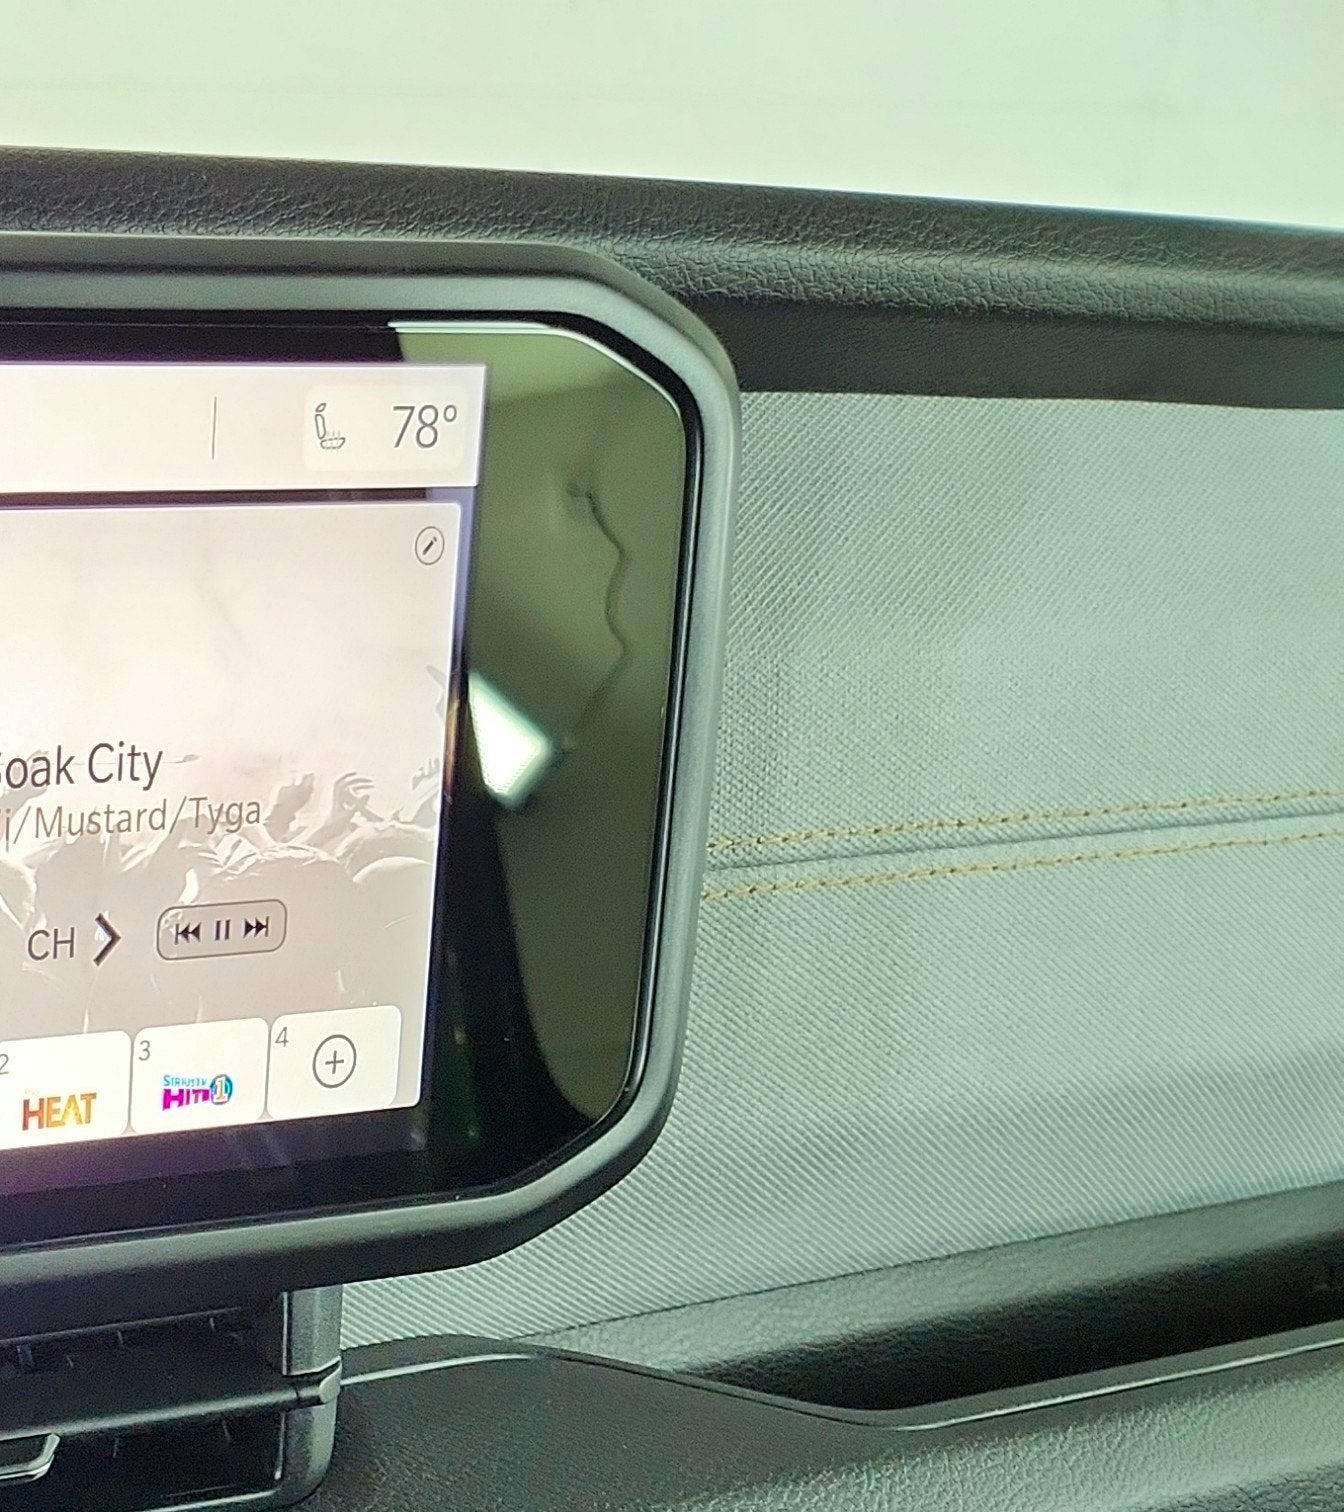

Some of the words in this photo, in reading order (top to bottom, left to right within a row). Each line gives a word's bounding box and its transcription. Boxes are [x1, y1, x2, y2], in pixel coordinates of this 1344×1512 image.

[392, 403, 458, 450] 78°
[88, 741, 164, 791] City
[27, 926, 76, 962] CH
[138, 1039, 152, 1062] 3
[275, 1026, 290, 1049] 4
[22, 1091, 98, 1132] HEAT
